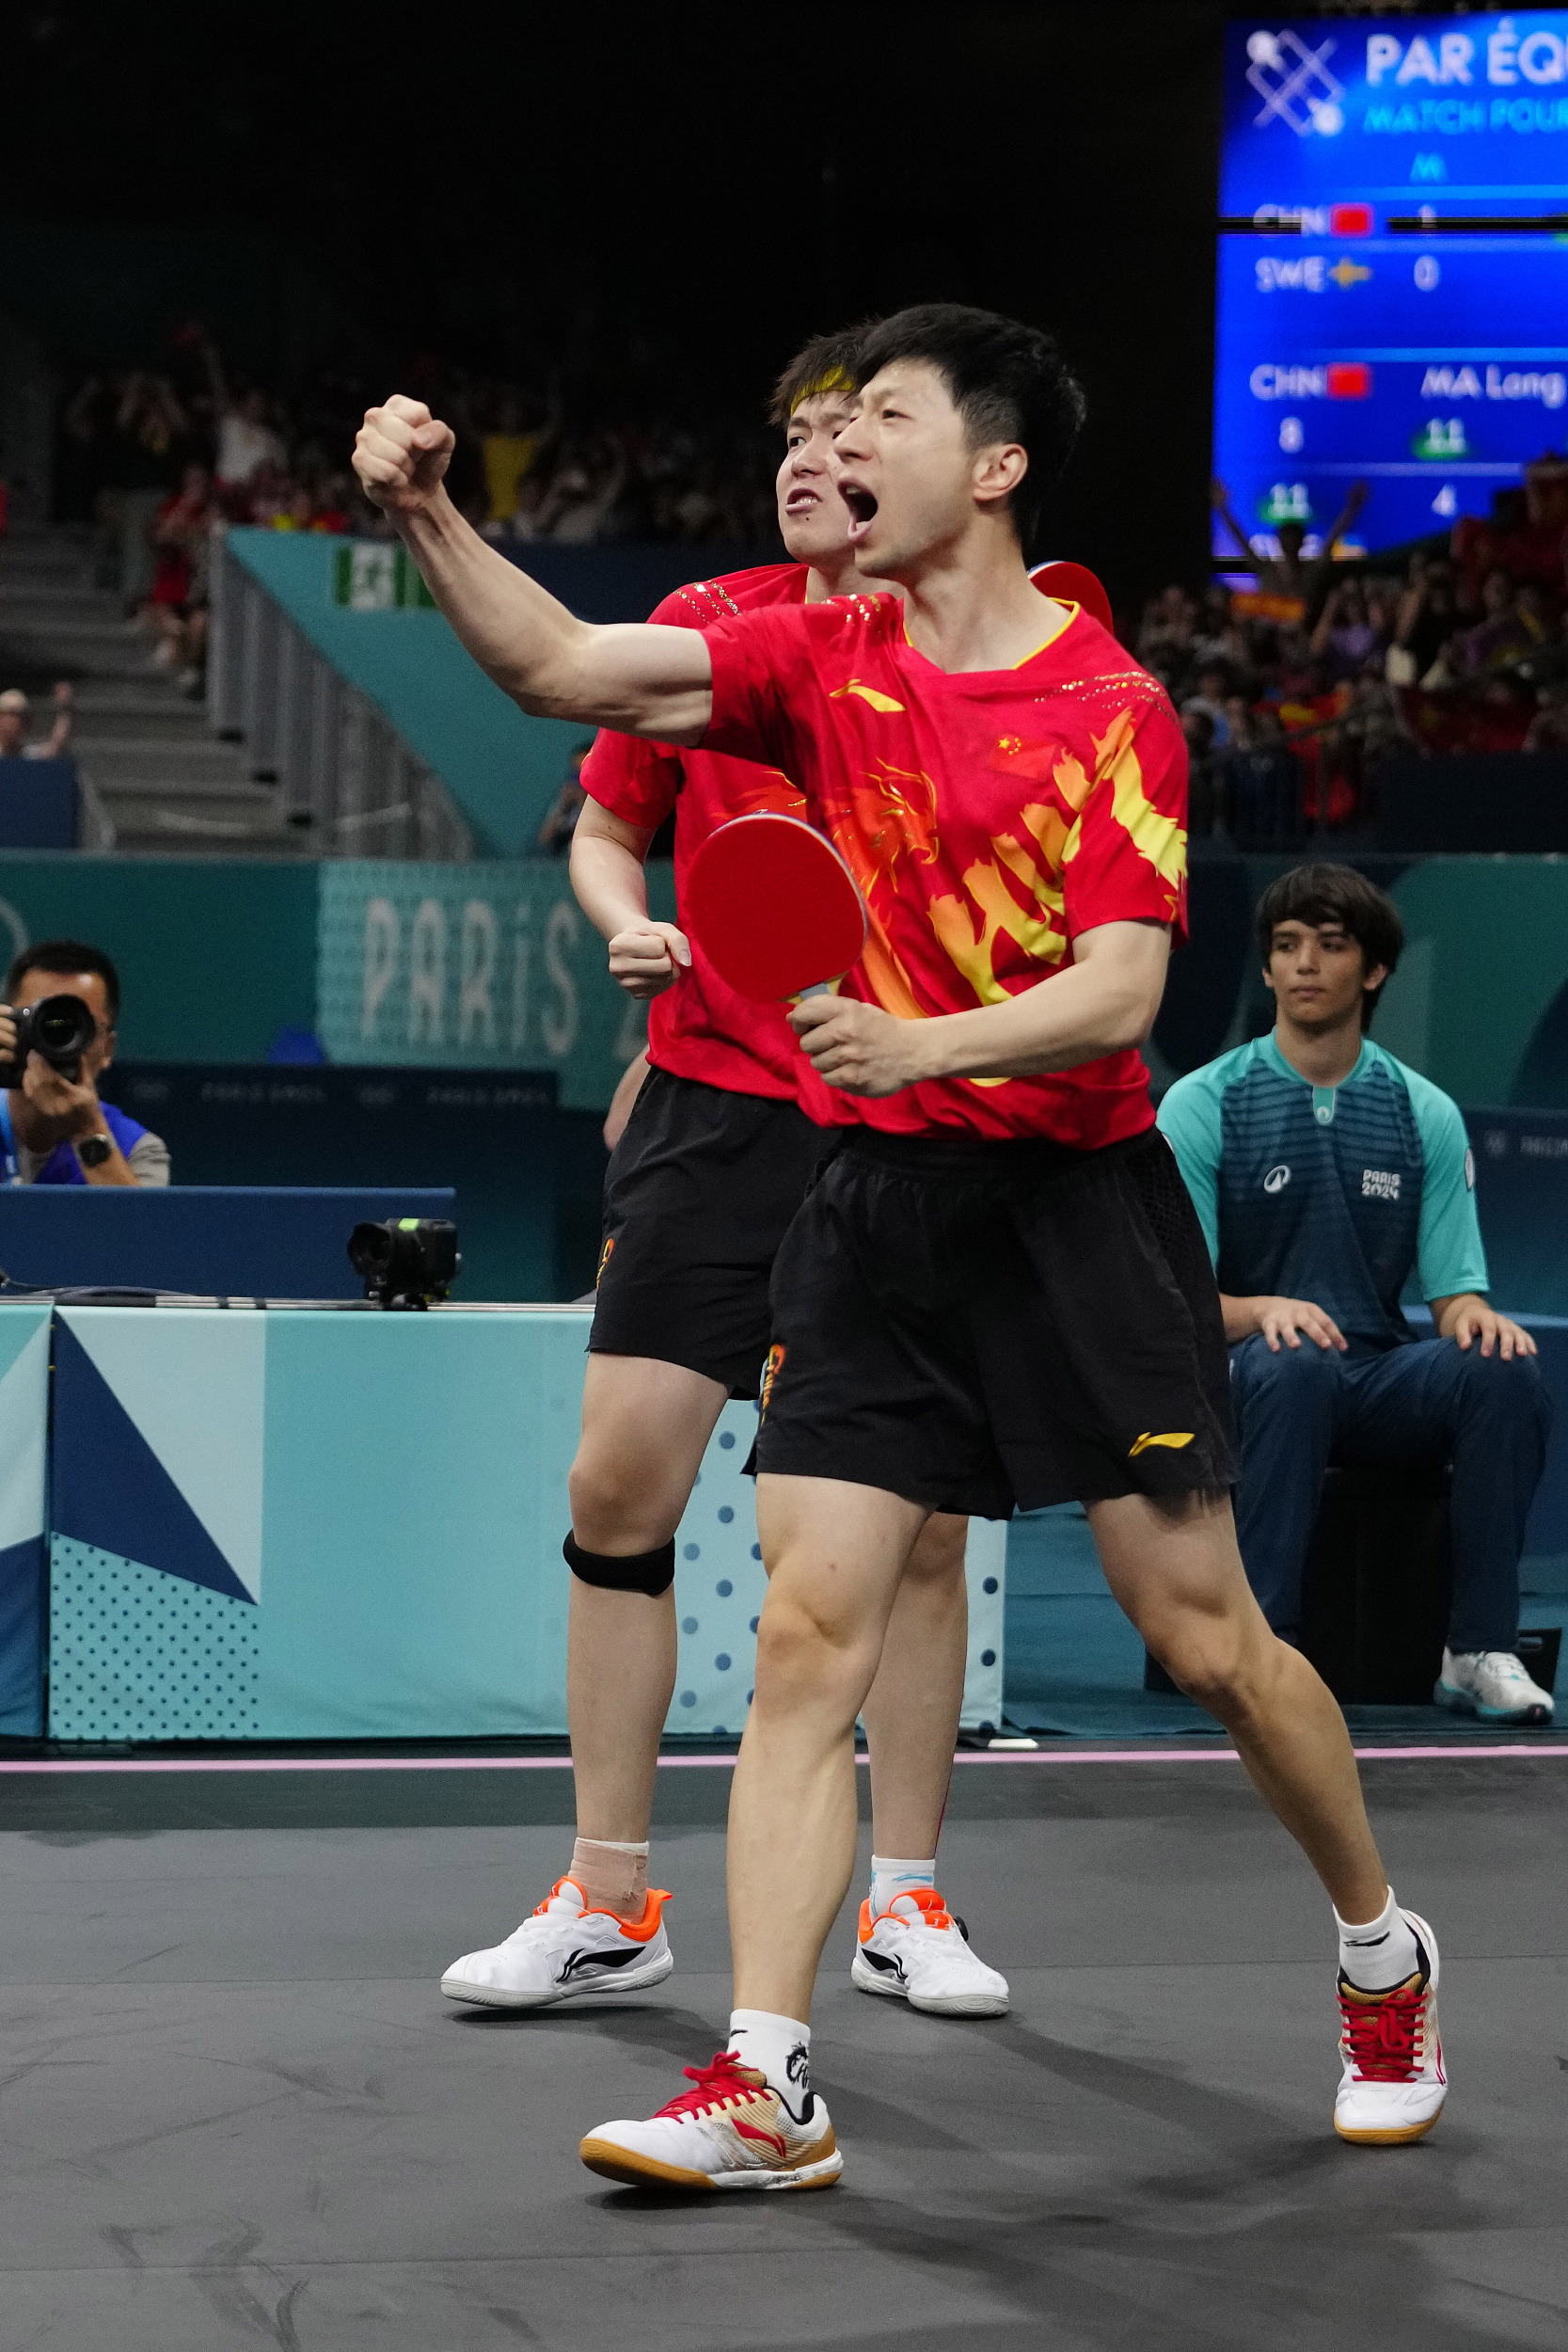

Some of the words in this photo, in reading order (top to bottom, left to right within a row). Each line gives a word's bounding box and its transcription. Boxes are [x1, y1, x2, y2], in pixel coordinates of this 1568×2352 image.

[1366, 33, 1475, 87] PAR
[1486, 16, 1568, 86] ÉQ
[1363, 99, 1486, 135] MATCH
[1255, 256, 1327, 293] SWE
[1249, 363, 1327, 401] CHN
[1420, 365, 1482, 399] MA
[1485, 363, 1567, 408] Long
[1362, 1182, 1400, 1200] 2024
